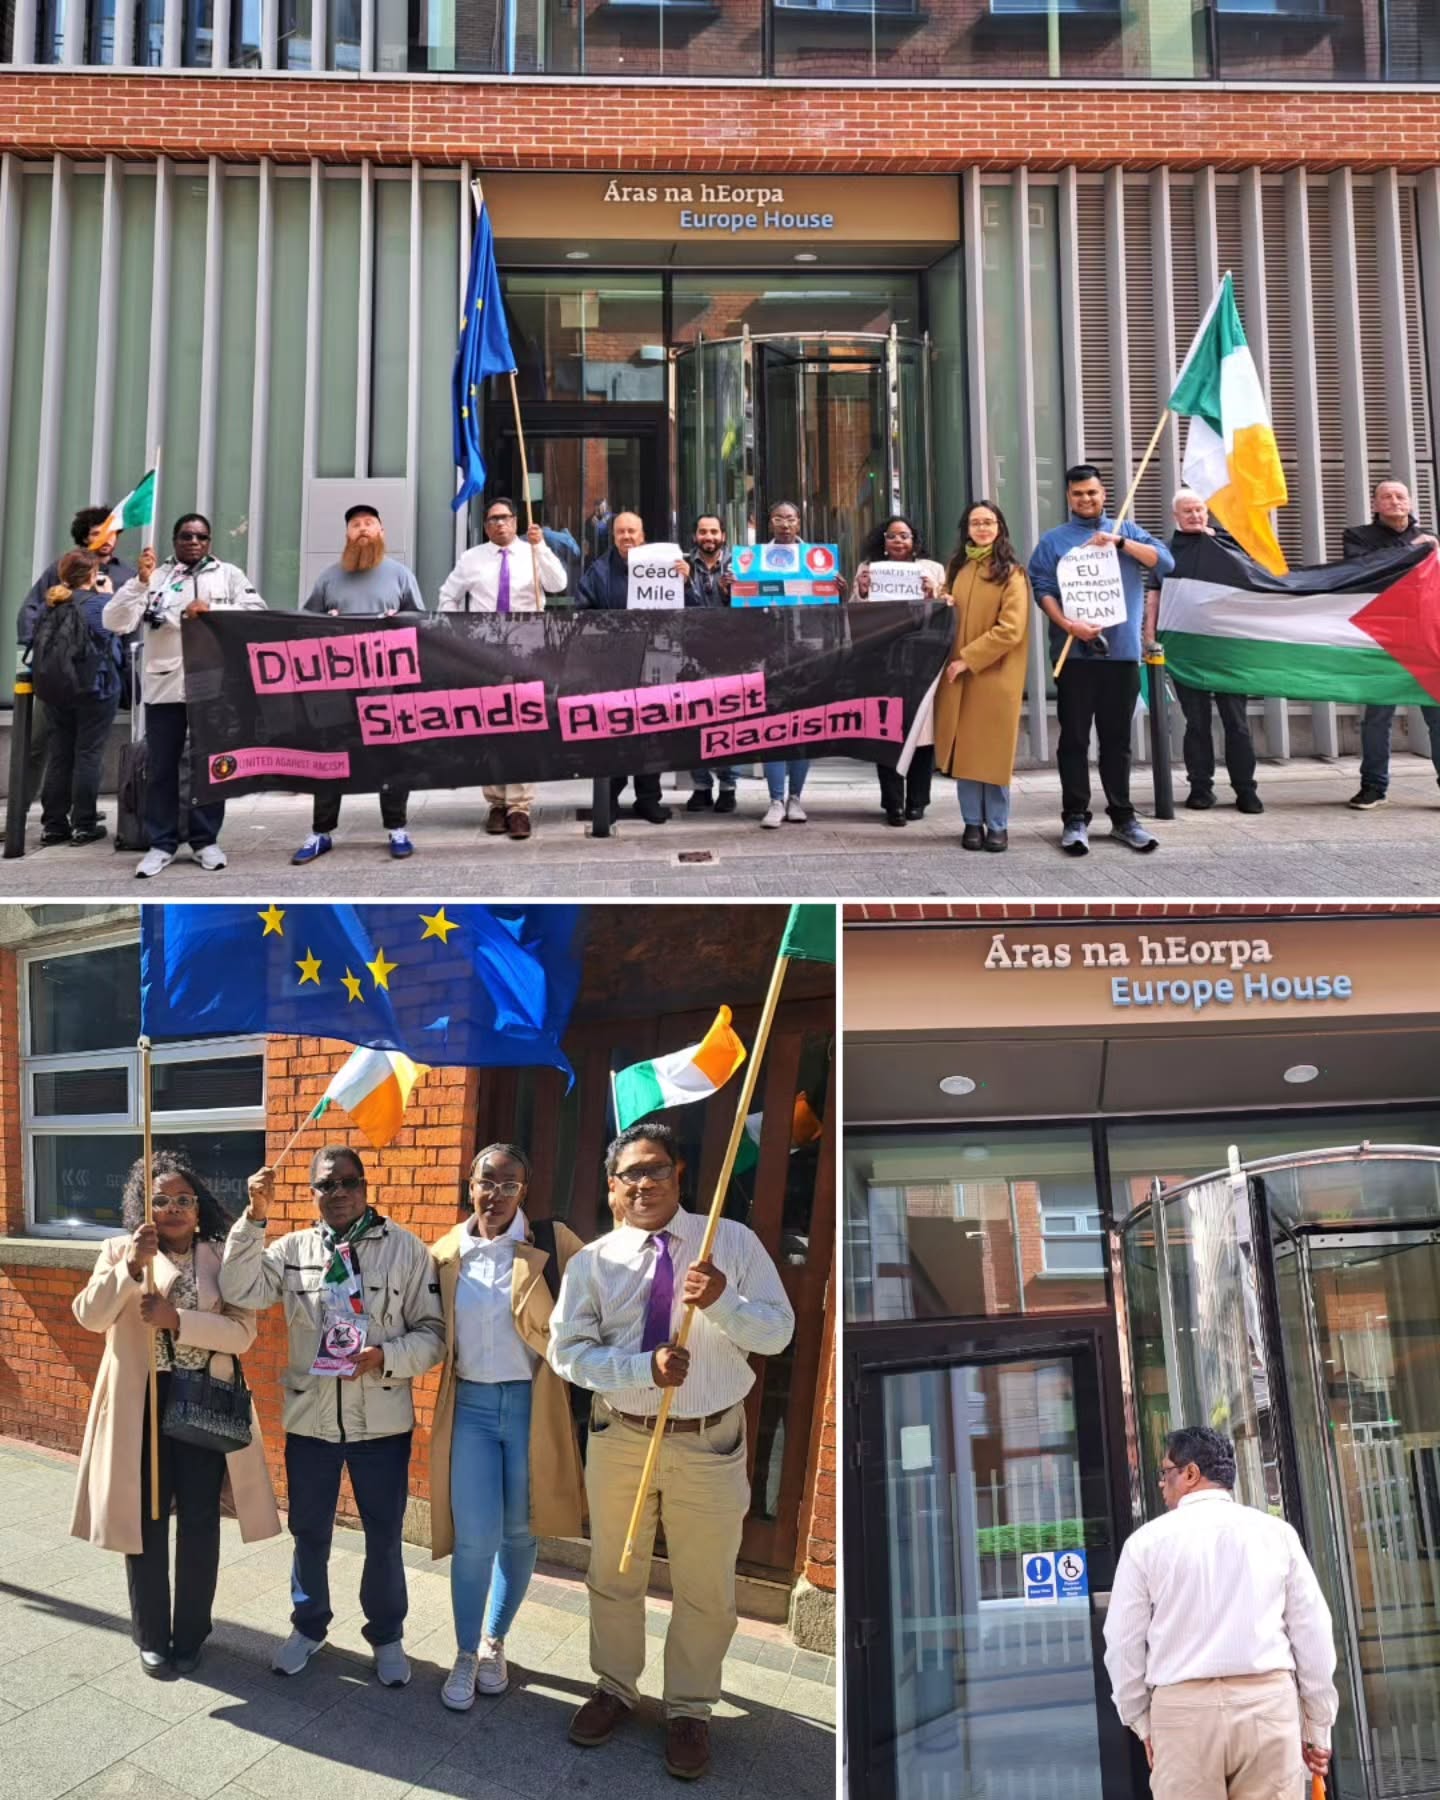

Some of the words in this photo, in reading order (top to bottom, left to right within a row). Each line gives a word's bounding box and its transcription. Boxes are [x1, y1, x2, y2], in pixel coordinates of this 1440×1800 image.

[604, 180, 658, 203] Áras
[664, 187, 693, 203] na
[700, 183, 785, 208] hEorpa
[679, 209, 758, 233] Europe
[764, 209, 834, 229] House
[1076, 564, 1100, 576] EU
[871, 582, 920, 595] DIGITAL
[1065, 588, 1120, 603] ACTION
[1076, 606, 1115, 619] PLAN
[255, 640, 417, 685] Dublin
[362, 693, 544, 737] Stands
[567, 688, 763, 736] Against
[239, 756, 273, 770] UNITED
[984, 934, 1072, 969] Áras
[1081, 944, 1131, 967] na
[1138, 935, 1273, 971] hEorpa
[1111, 976, 1235, 1011] Europe
[1243, 973, 1353, 1001] House
